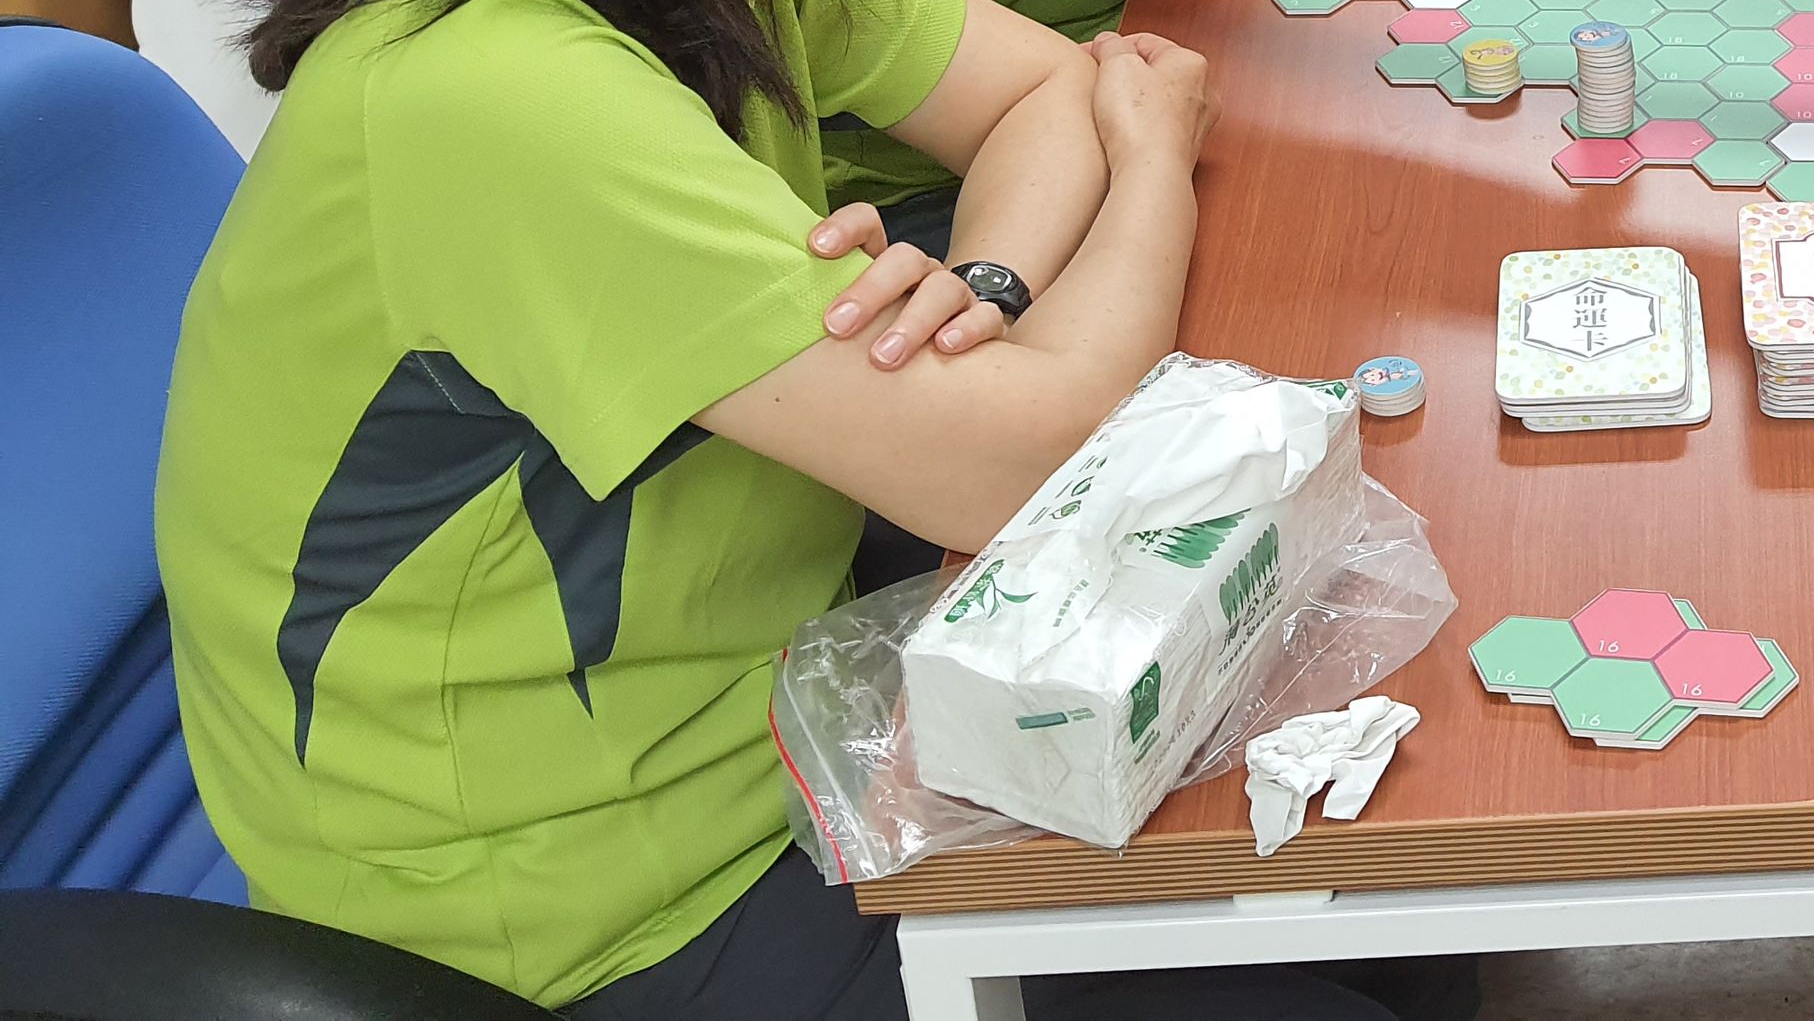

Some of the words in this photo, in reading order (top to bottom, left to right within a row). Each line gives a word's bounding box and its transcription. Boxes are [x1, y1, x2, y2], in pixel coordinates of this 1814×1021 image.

[1450, 21, 1463, 29] 12
[1572, 286, 1608, 352] 命運卡
[1599, 640, 1619, 654] 16
[1496, 669, 1516, 683] 16
[1682, 684, 1703, 697] 16
[1580, 713, 1601, 727] 16
